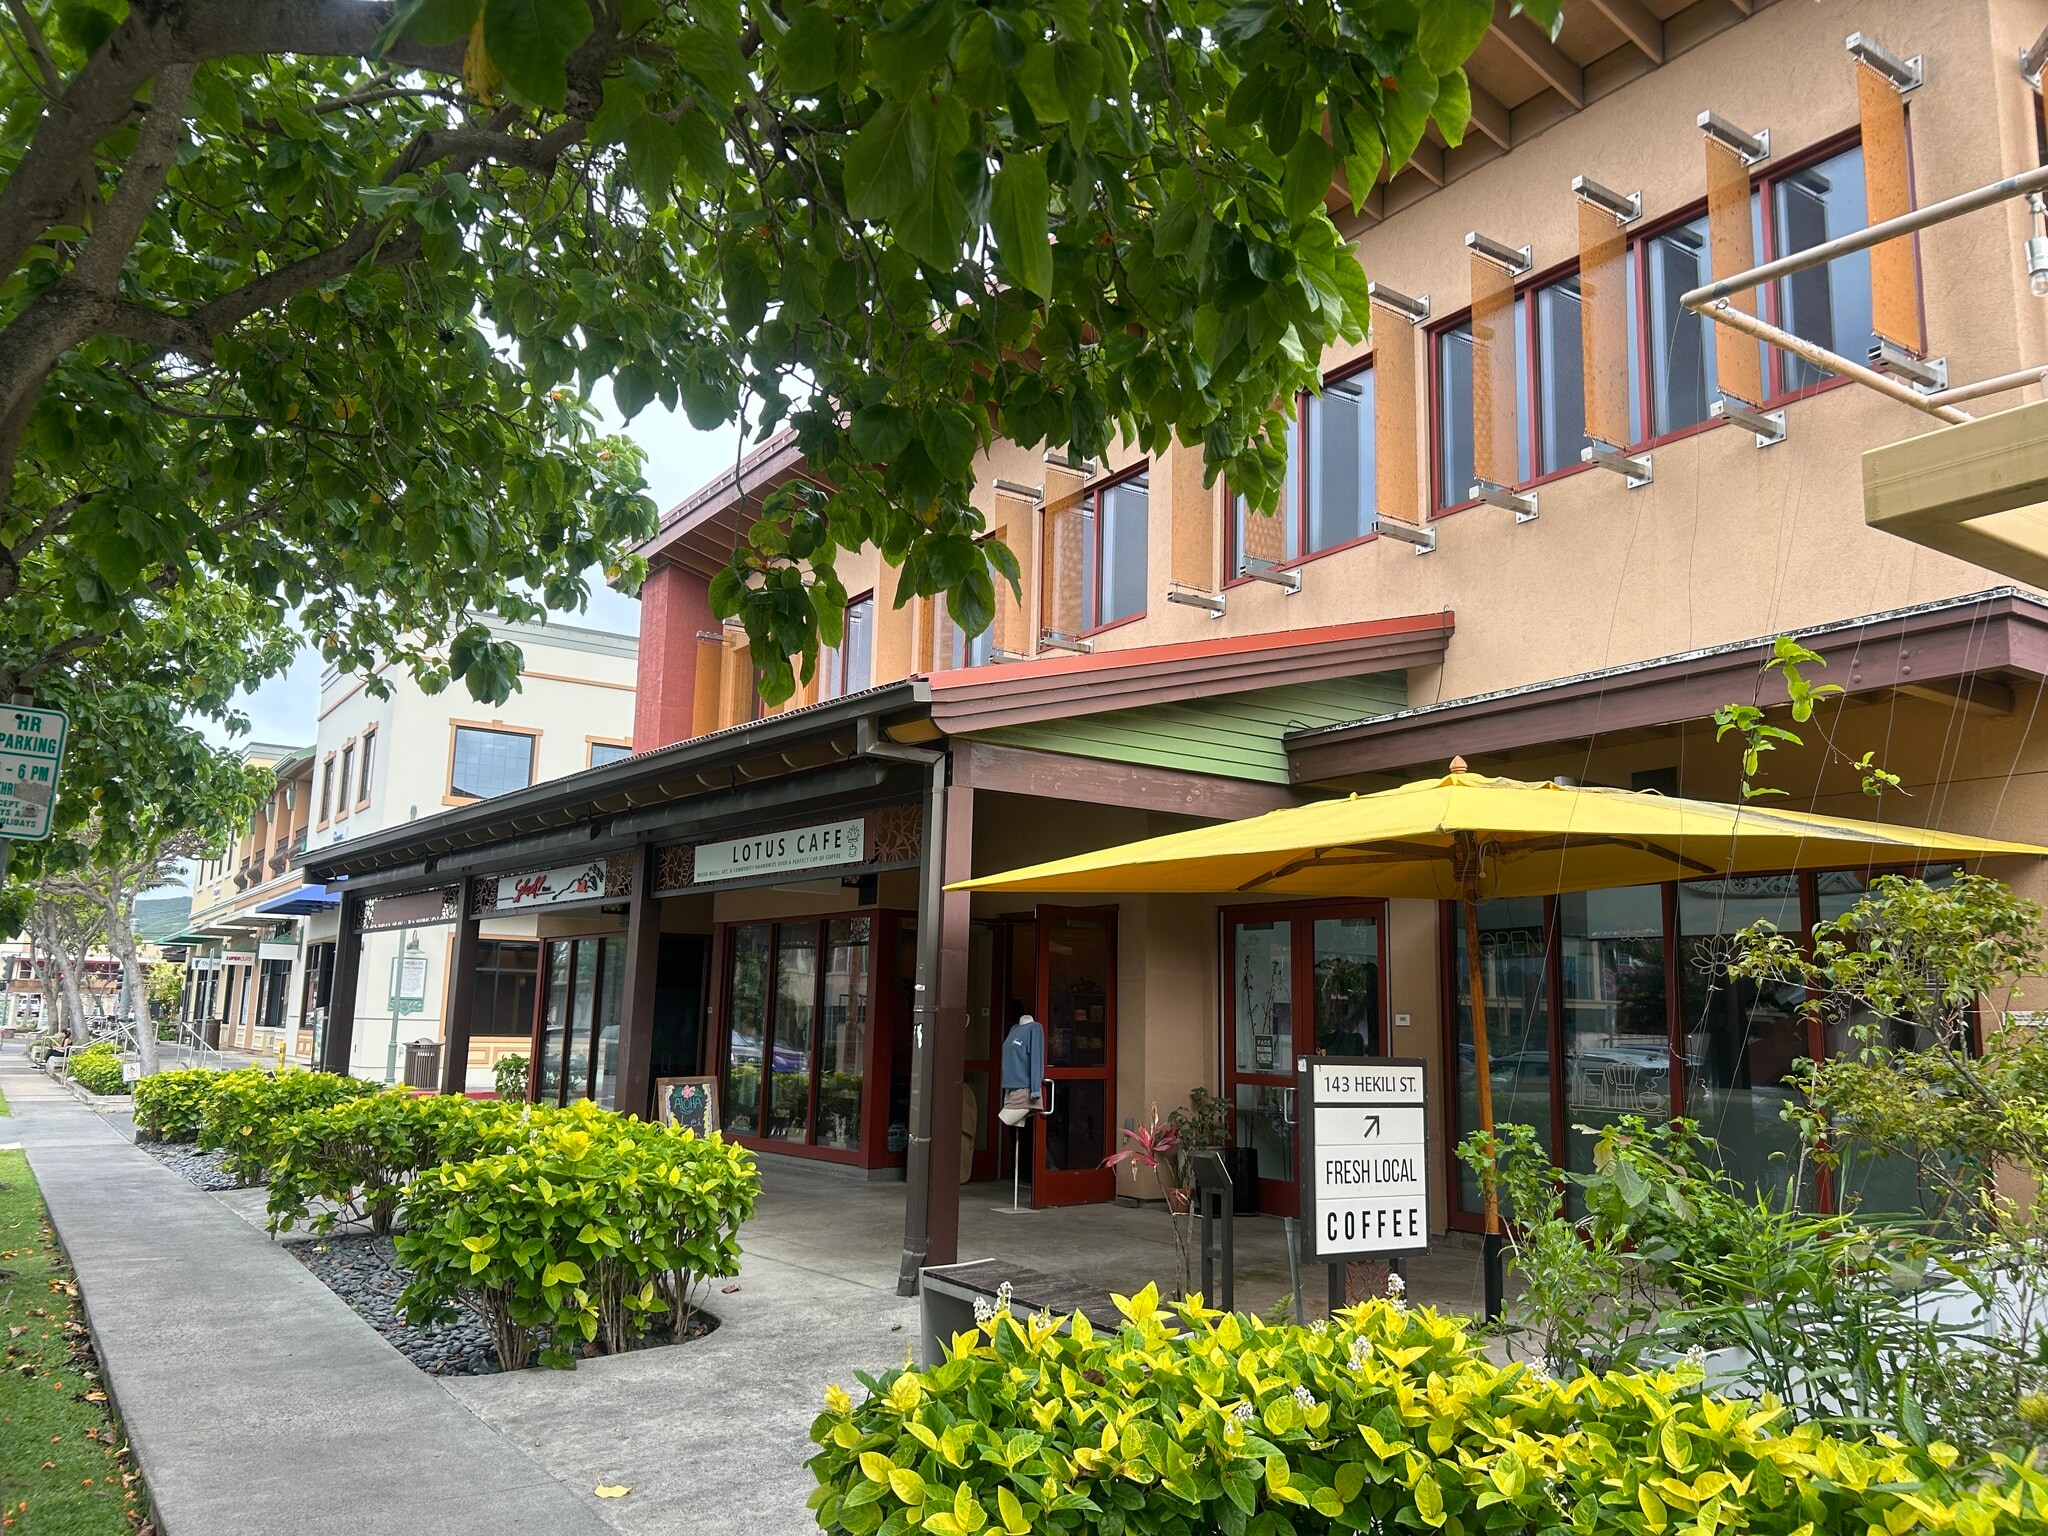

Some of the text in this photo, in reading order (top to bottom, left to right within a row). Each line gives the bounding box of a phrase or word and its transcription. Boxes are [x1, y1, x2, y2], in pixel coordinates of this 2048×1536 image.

[17, 715, 42, 733] HR
[0, 733, 57, 754] PARKING
[30, 765, 50, 782] PM
[733, 828, 842, 863] LOTUS CAFE
[1479, 928, 1543, 957] OPEN
[1324, 1076, 1417, 1093] 143 HEKILI ST.
[674, 1097, 702, 1113] ALOHA
[1326, 1158, 1417, 1185] FRESH LOCAL
[1327, 1208, 1418, 1241] COFFEE
